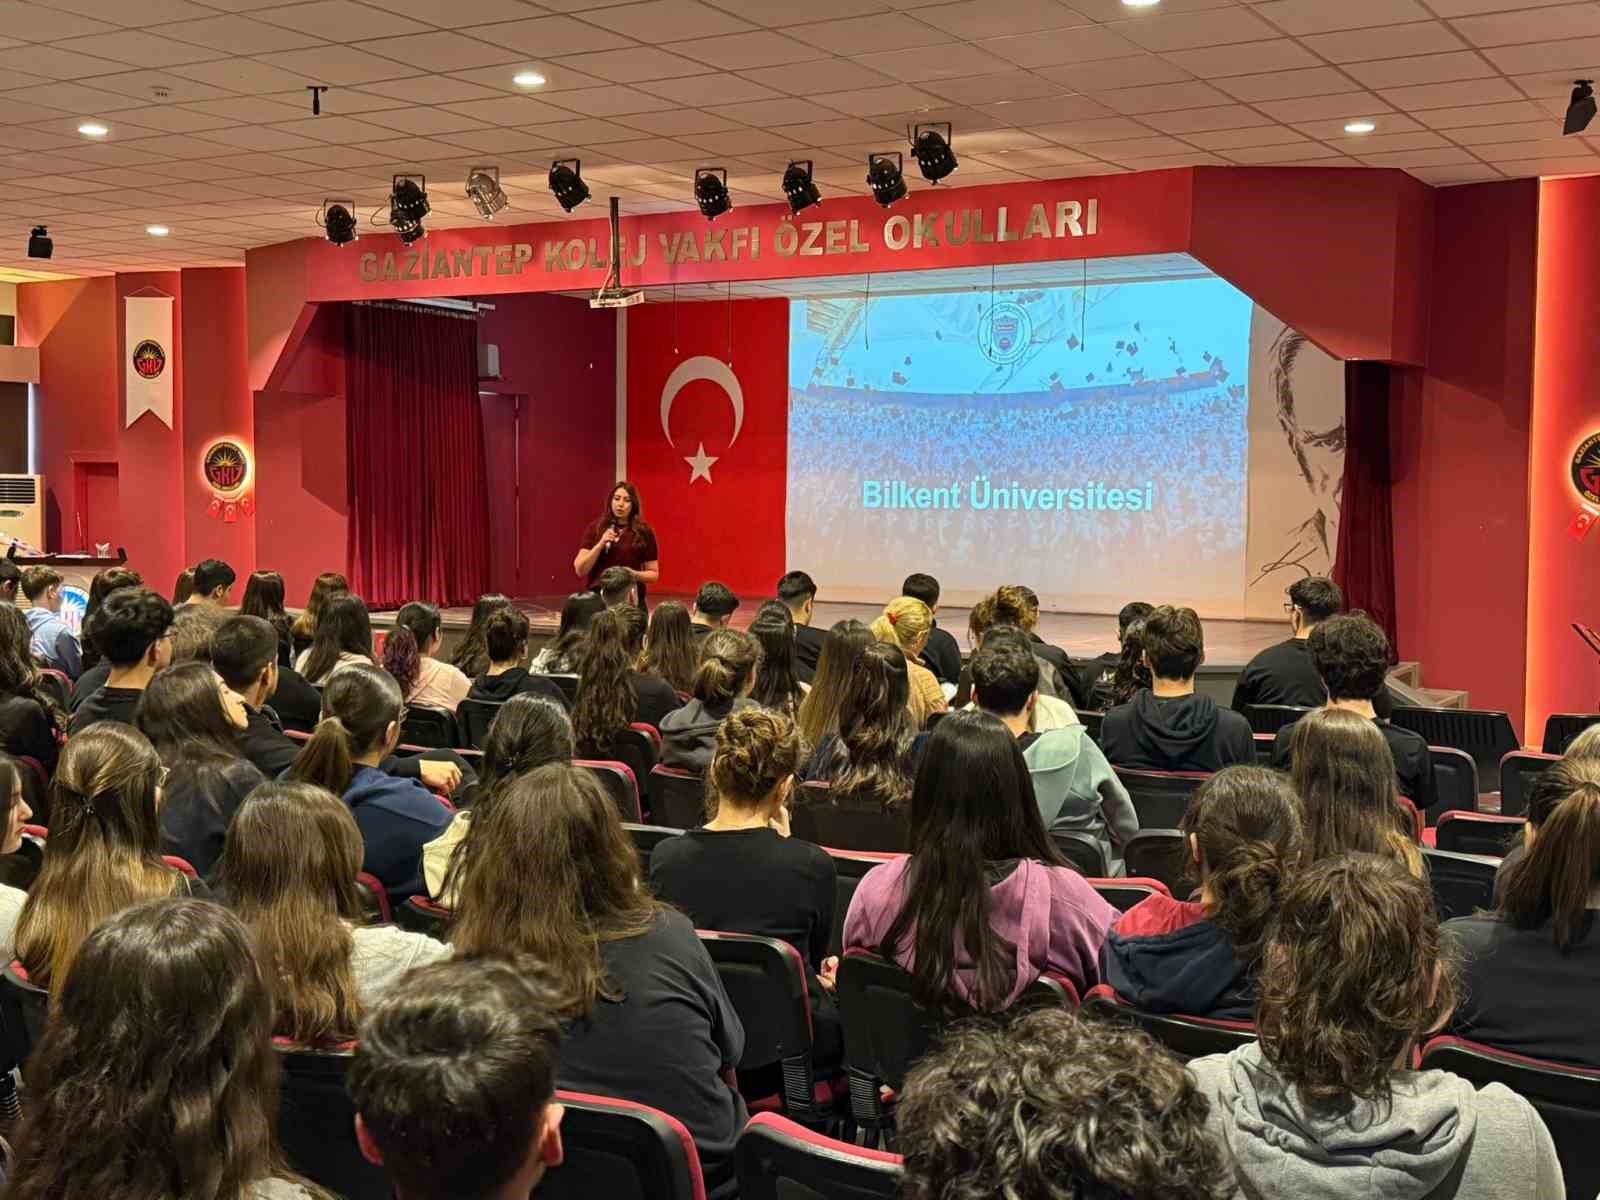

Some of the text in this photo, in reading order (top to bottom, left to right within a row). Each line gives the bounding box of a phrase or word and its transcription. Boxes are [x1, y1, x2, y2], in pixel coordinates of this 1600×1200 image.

[359, 239, 532, 283] GAZİANTEP
[659, 226, 760, 265] VAKFI
[774, 214, 869, 257] ÖZEL
[883, 198, 1097, 250] OKULLARI
[862, 475, 1153, 511] Bilkent Üniversitesi
